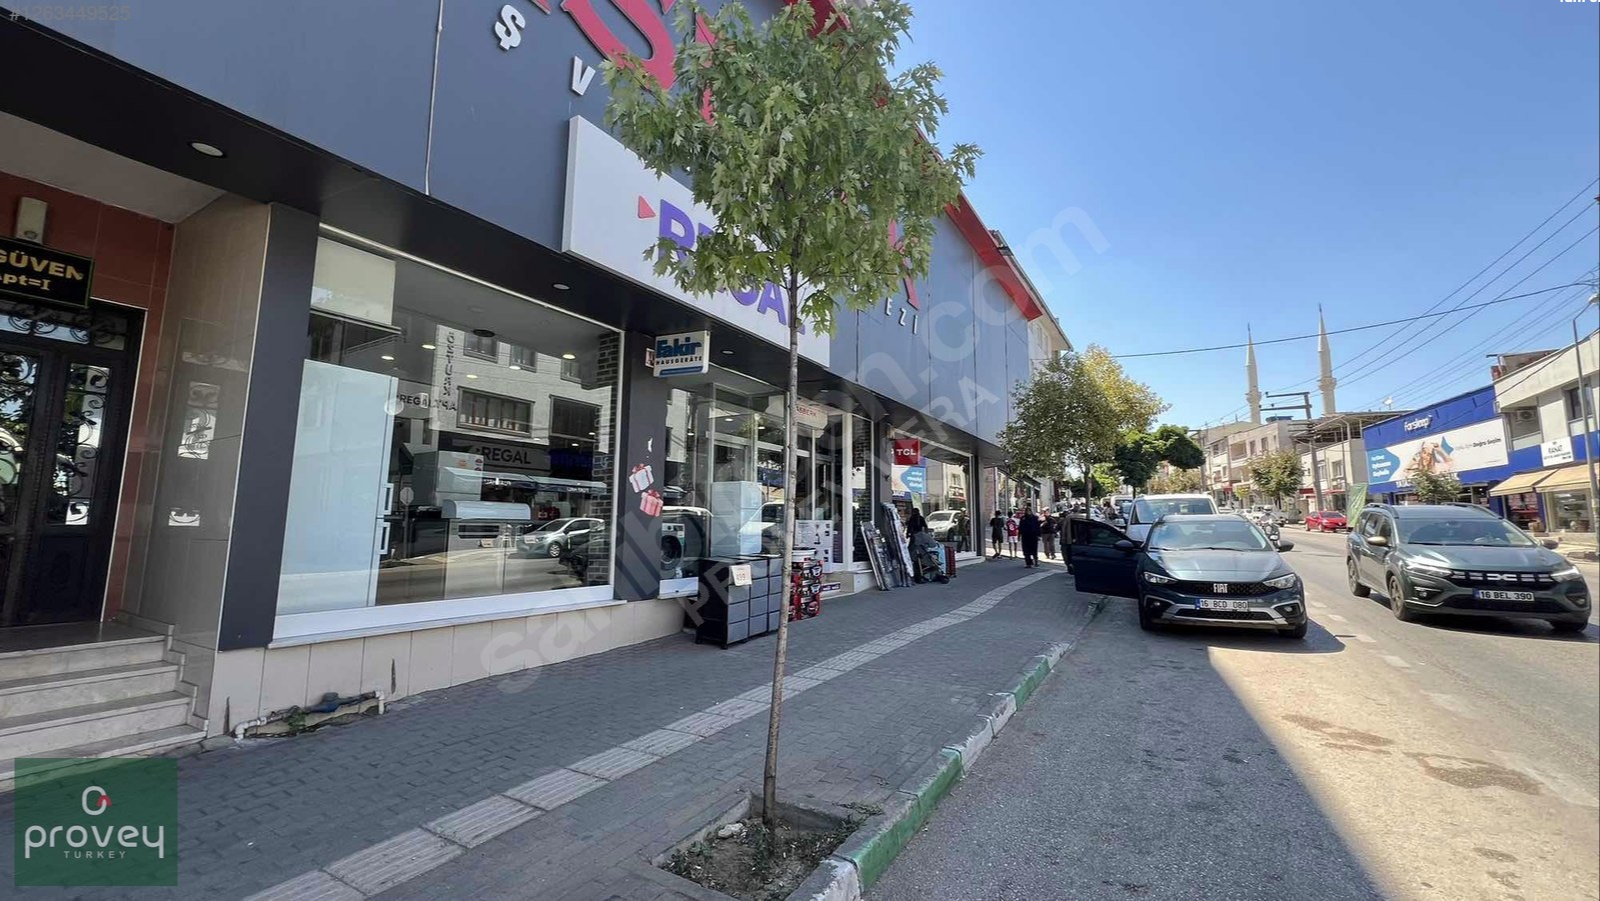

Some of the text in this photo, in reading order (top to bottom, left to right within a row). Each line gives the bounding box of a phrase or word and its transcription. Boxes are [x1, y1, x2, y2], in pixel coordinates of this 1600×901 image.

[656, 337, 702, 357] Fakir
[483, 448, 532, 465] REGAL
[896, 448, 917, 456] TCL
[1213, 583, 1228, 593] FIAT
[1480, 590, 1532, 601] 16 BEL 390
